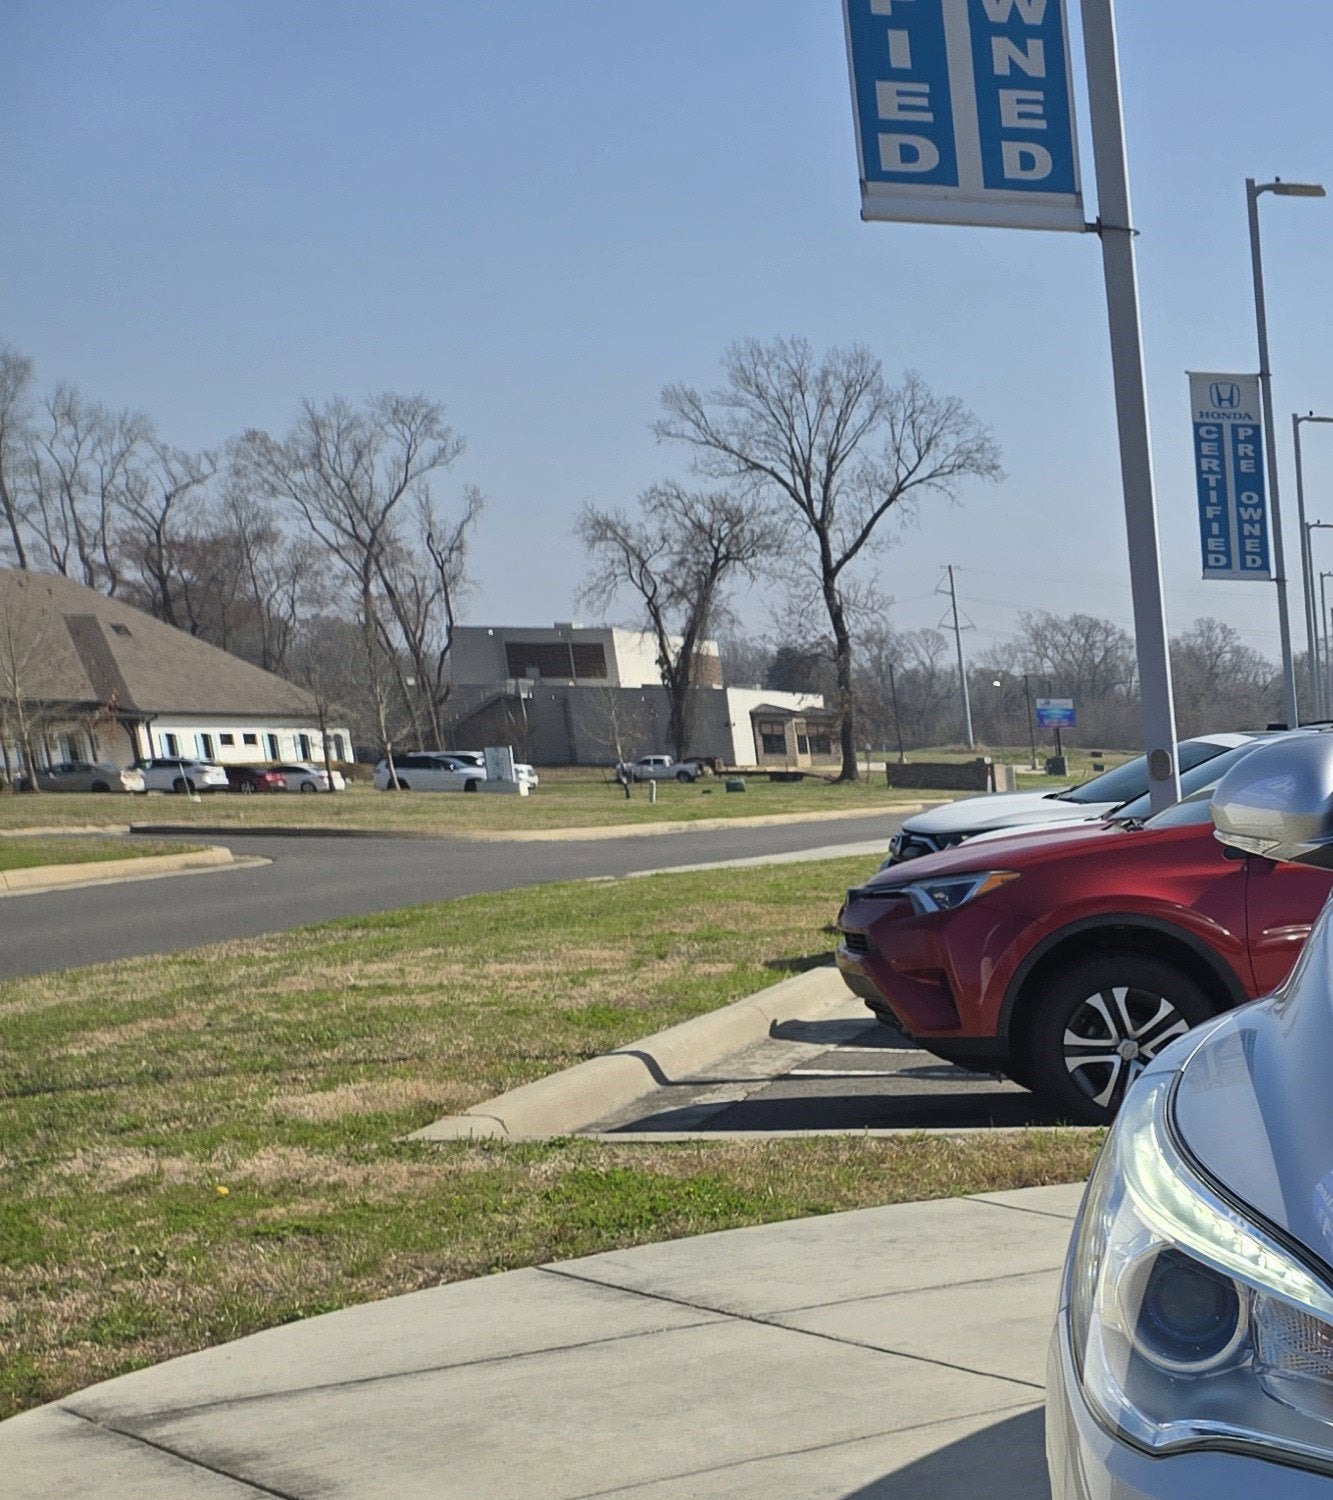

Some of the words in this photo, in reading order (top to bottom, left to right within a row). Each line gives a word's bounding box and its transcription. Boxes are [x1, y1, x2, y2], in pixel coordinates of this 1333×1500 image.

[1199, 410, 1253, 421] HONDA
[1237, 427, 1256, 473] PRE
[1199, 425, 1228, 569] CERTIFIED
[1239, 491, 1263, 569] OWNED
